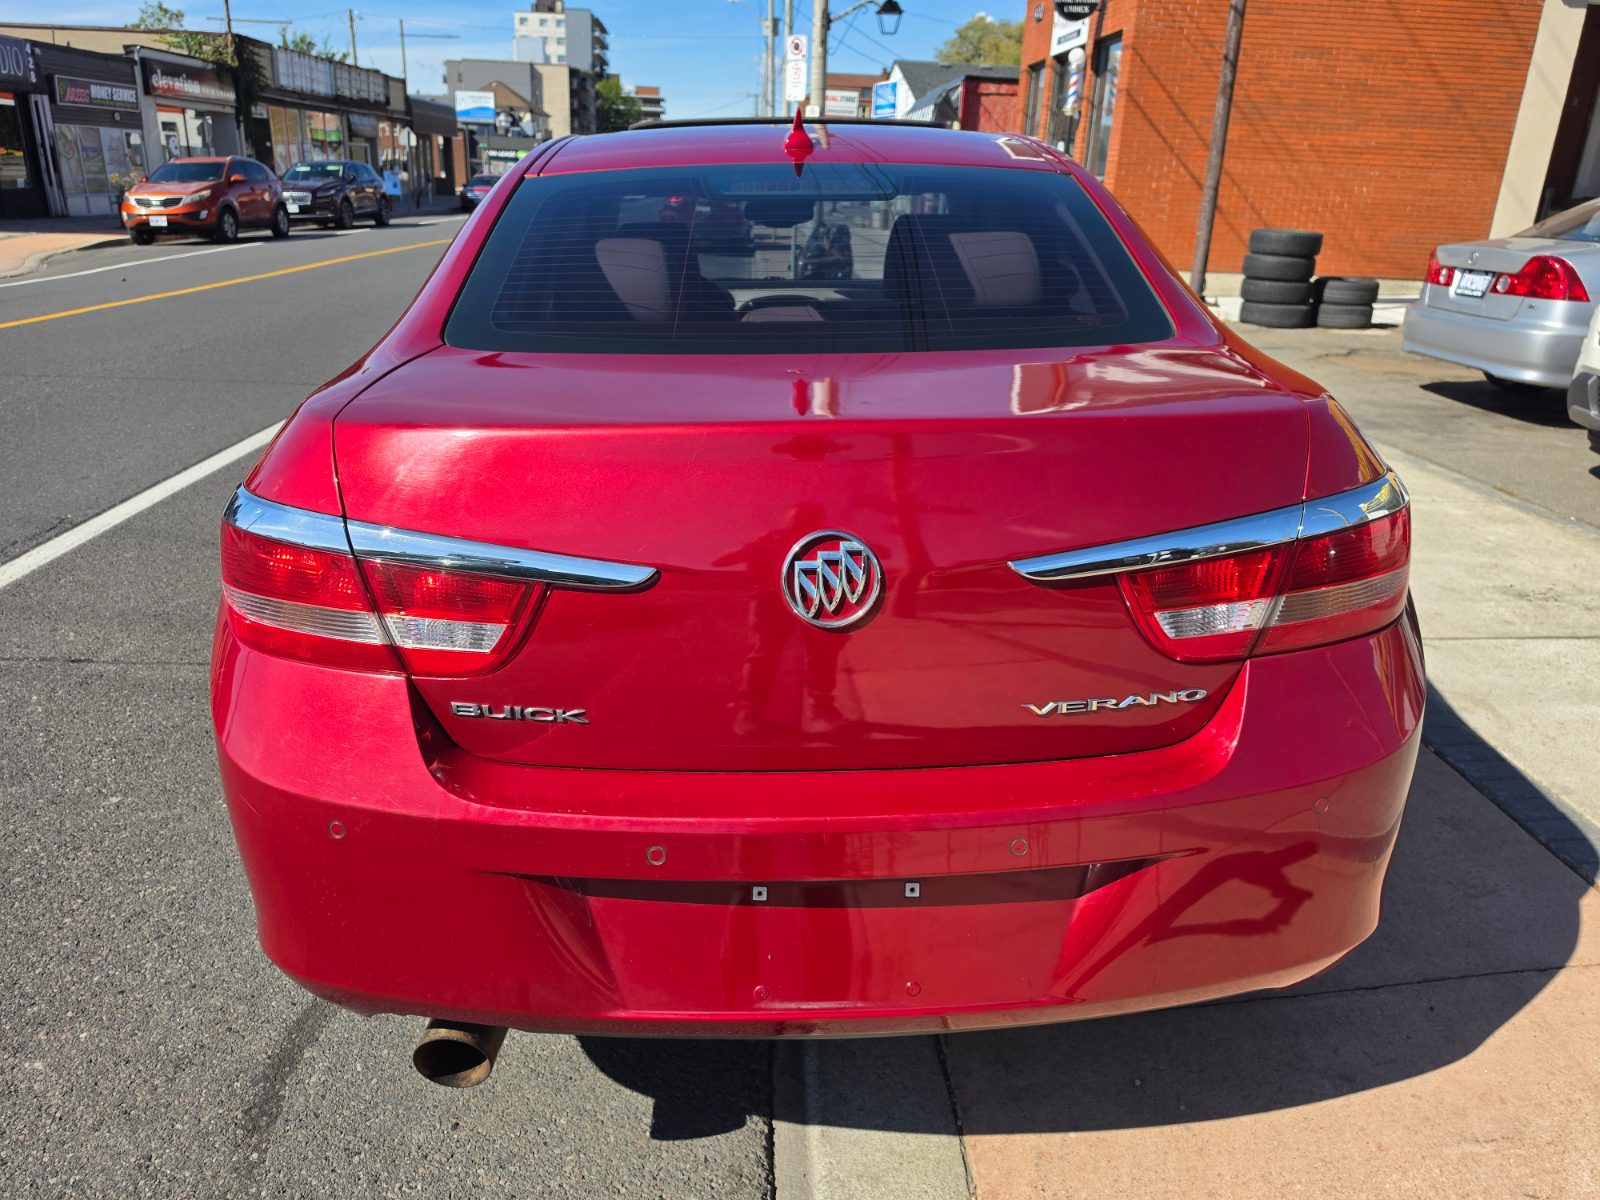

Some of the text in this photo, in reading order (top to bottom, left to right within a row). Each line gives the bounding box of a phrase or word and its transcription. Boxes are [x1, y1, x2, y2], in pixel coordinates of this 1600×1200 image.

[151, 68, 201, 94] elevation
[90, 84, 112, 99] MONEY
[112, 86, 137, 103] SERVICE
[450, 701, 590, 724] BUICK
[1020, 687, 1208, 715] VERANO
